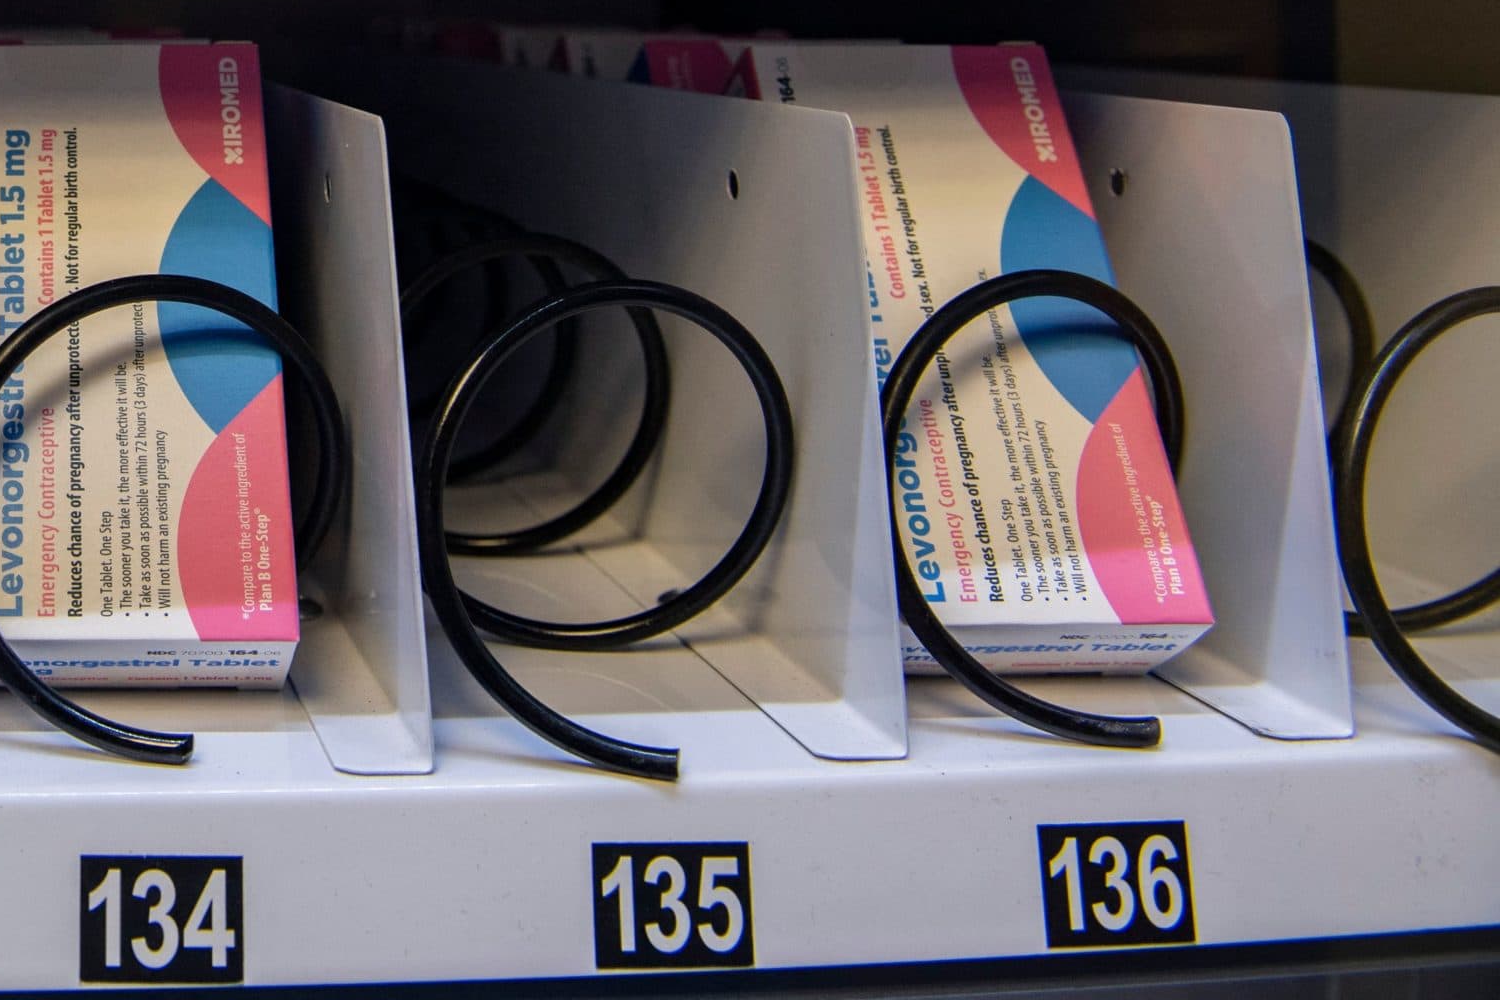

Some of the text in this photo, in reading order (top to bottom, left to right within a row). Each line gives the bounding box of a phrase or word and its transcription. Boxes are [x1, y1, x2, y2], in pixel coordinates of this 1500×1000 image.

[5, 130, 30, 175] mg
[41, 129, 57, 151] mg
[855, 126, 871, 147] mg
[37, 154, 53, 174] 1.5
[857, 151, 876, 171] 1.5
[0, 185, 24, 224] 1.5
[36, 179, 53, 224] Tablet
[864, 175, 887, 220] Tablet
[36, 241, 55, 306] Contains
[881, 236, 907, 300] Contains
[63, 127, 84, 617] Reduces chance of pregnancy after Not for regular birth control.
[232, 433, 245, 444] of
[233, 445, 251, 497] ingredient
[35, 407, 60, 617] Emergency Contraceptive
[155, 429, 171, 609] Will not harm an existing pregnancy
[236, 499, 250, 529] active
[917, 398, 978, 602] Emergency Contraceptive
[238, 532, 251, 549] the
[241, 551, 252, 562] to
[99, 510, 114, 617] One Tablet. One Step
[257, 571, 270, 579] B
[259, 583, 273, 610] Plan
[601, 856, 744, 953] 135
[1050, 835, 1184, 933] 136
[88, 868, 235, 969] 134
